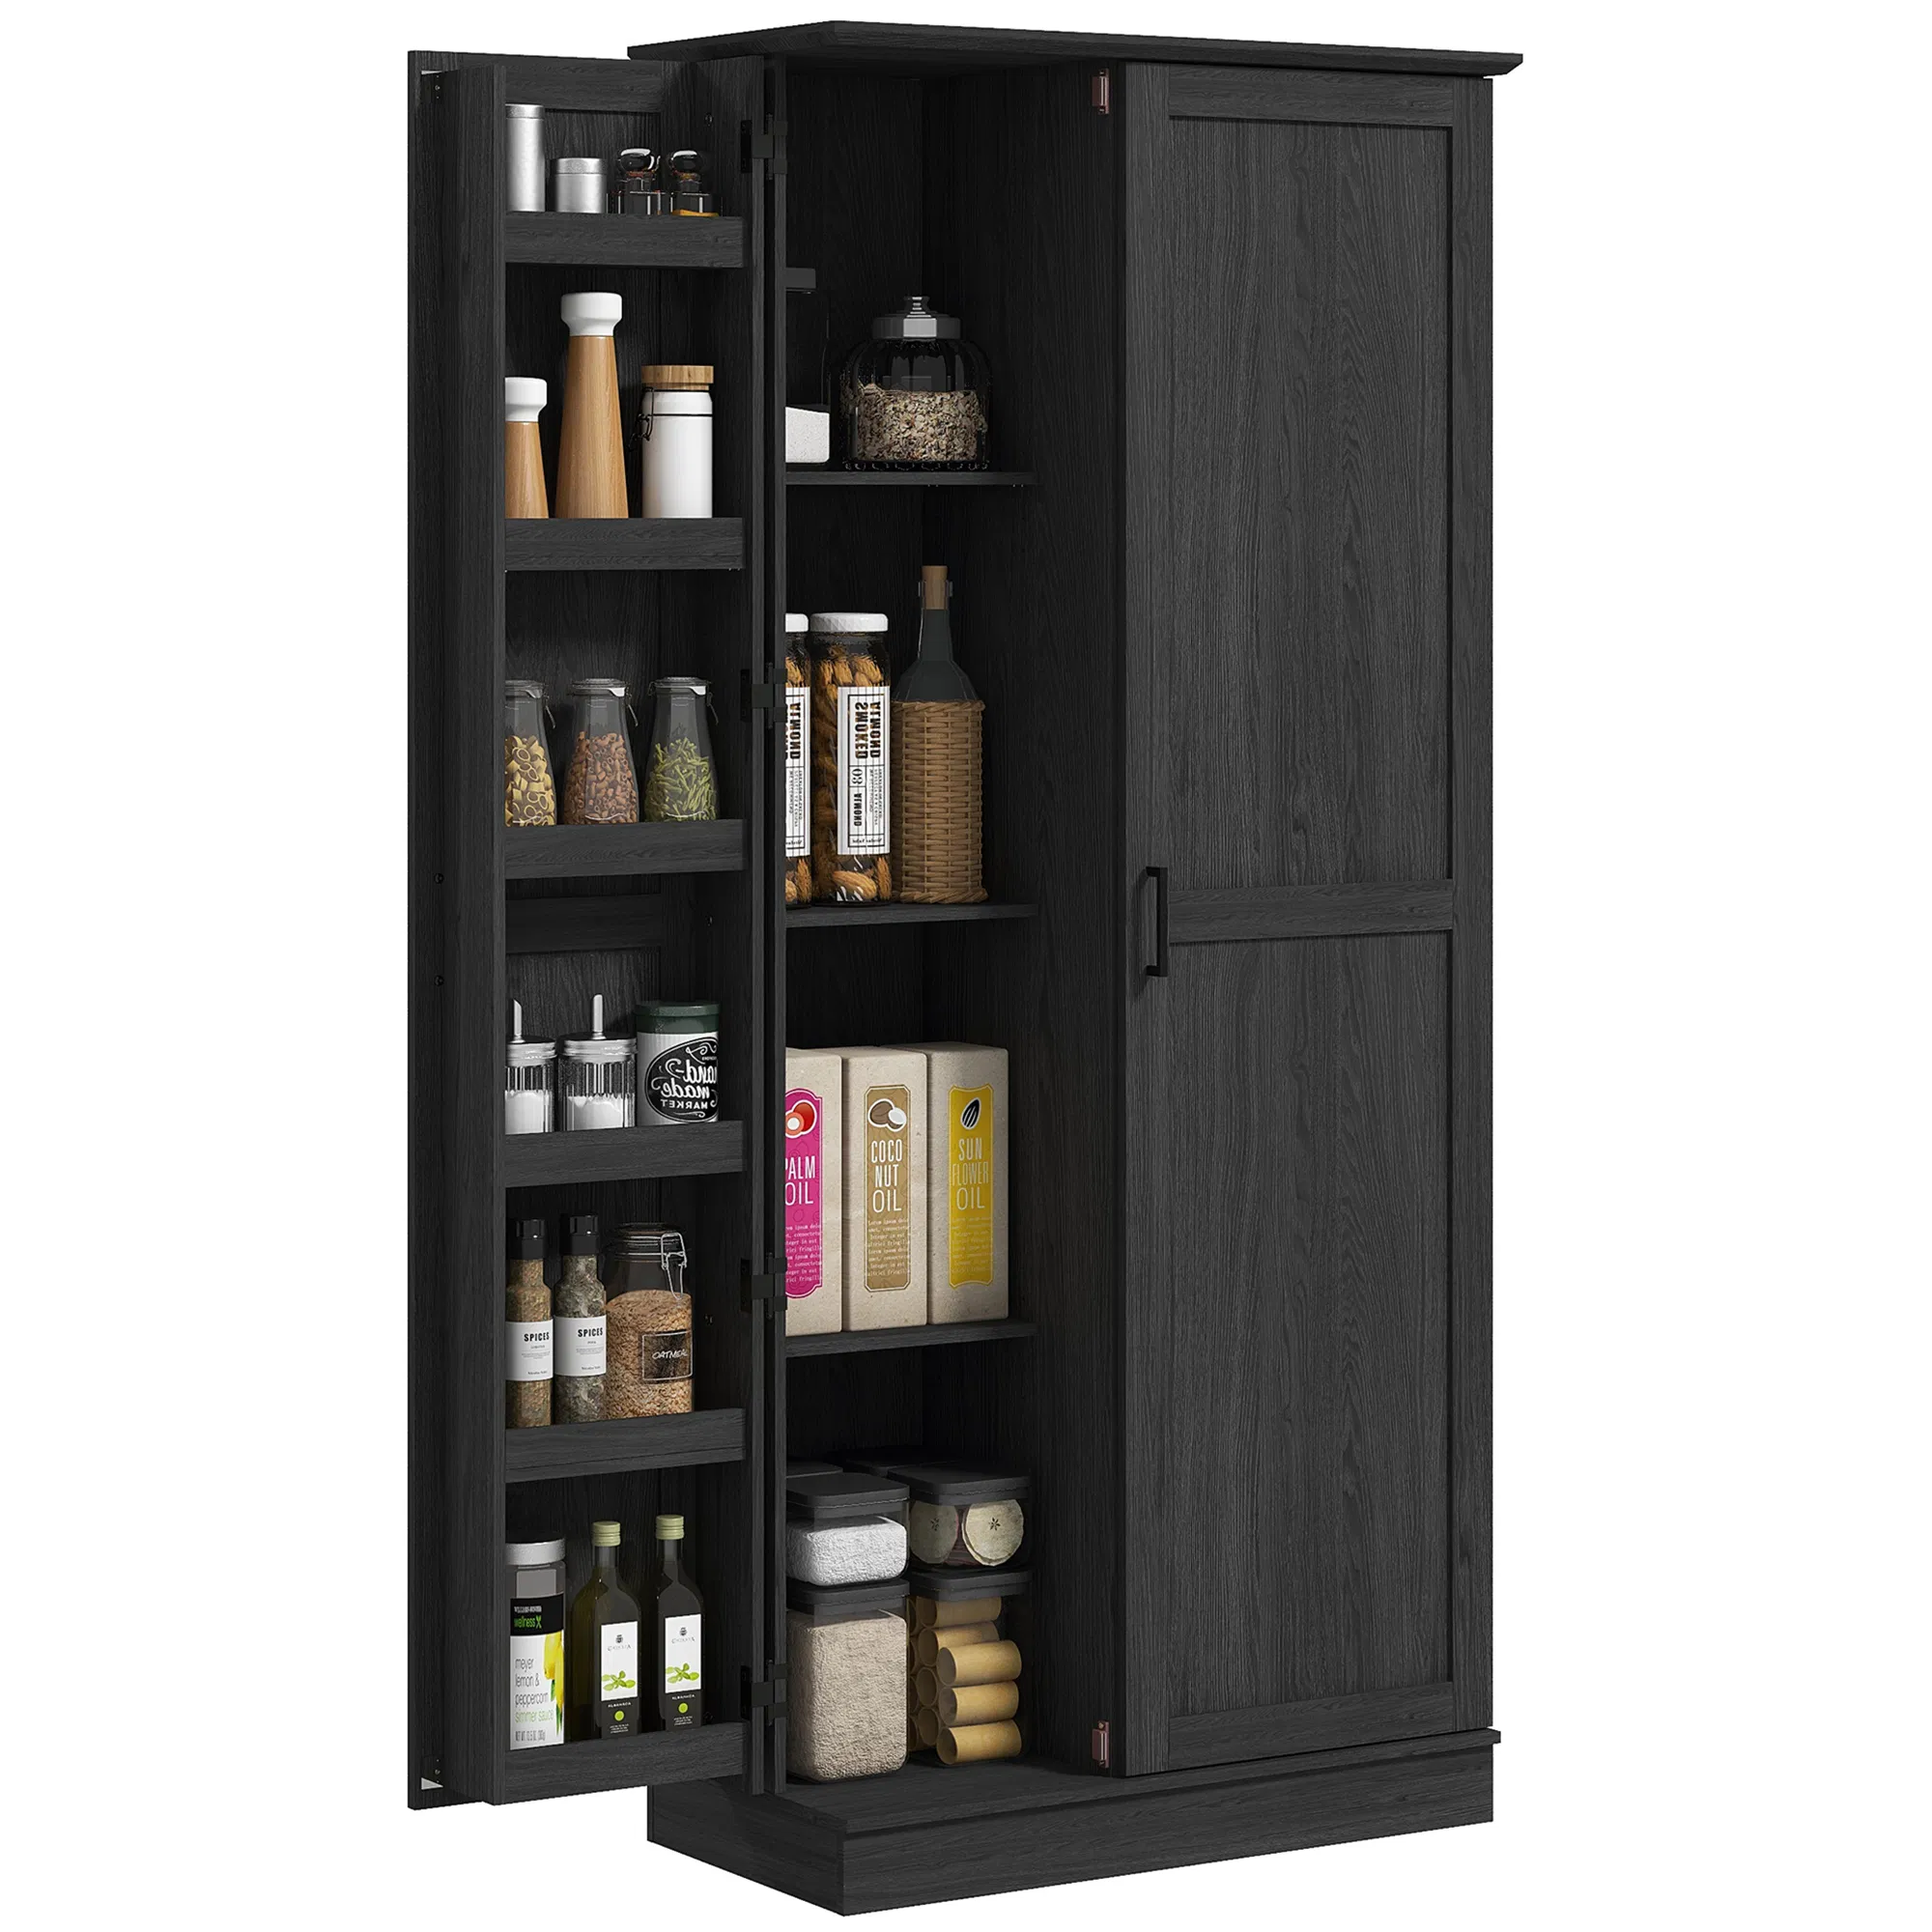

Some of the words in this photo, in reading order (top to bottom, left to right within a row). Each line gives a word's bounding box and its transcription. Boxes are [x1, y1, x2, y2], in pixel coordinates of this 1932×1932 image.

[871, 1139, 902, 1163] COCO
[958, 1137, 982, 1161] SUN
[875, 1163, 898, 1188] NUT
[952, 1161, 989, 1186] FLOWER
[785, 1180, 813, 1206] OIL
[872, 1188, 902, 1213] OIL
[956, 1186, 985, 1211] OIL
[524, 1331, 550, 1343] SPICES
[578, 1327, 603, 1337] SPICES
[515, 1658, 533, 1672] meyer
[515, 1675, 533, 1688] lemon
[535, 1673, 540, 1687] &
[515, 1710, 537, 1723] simmer
